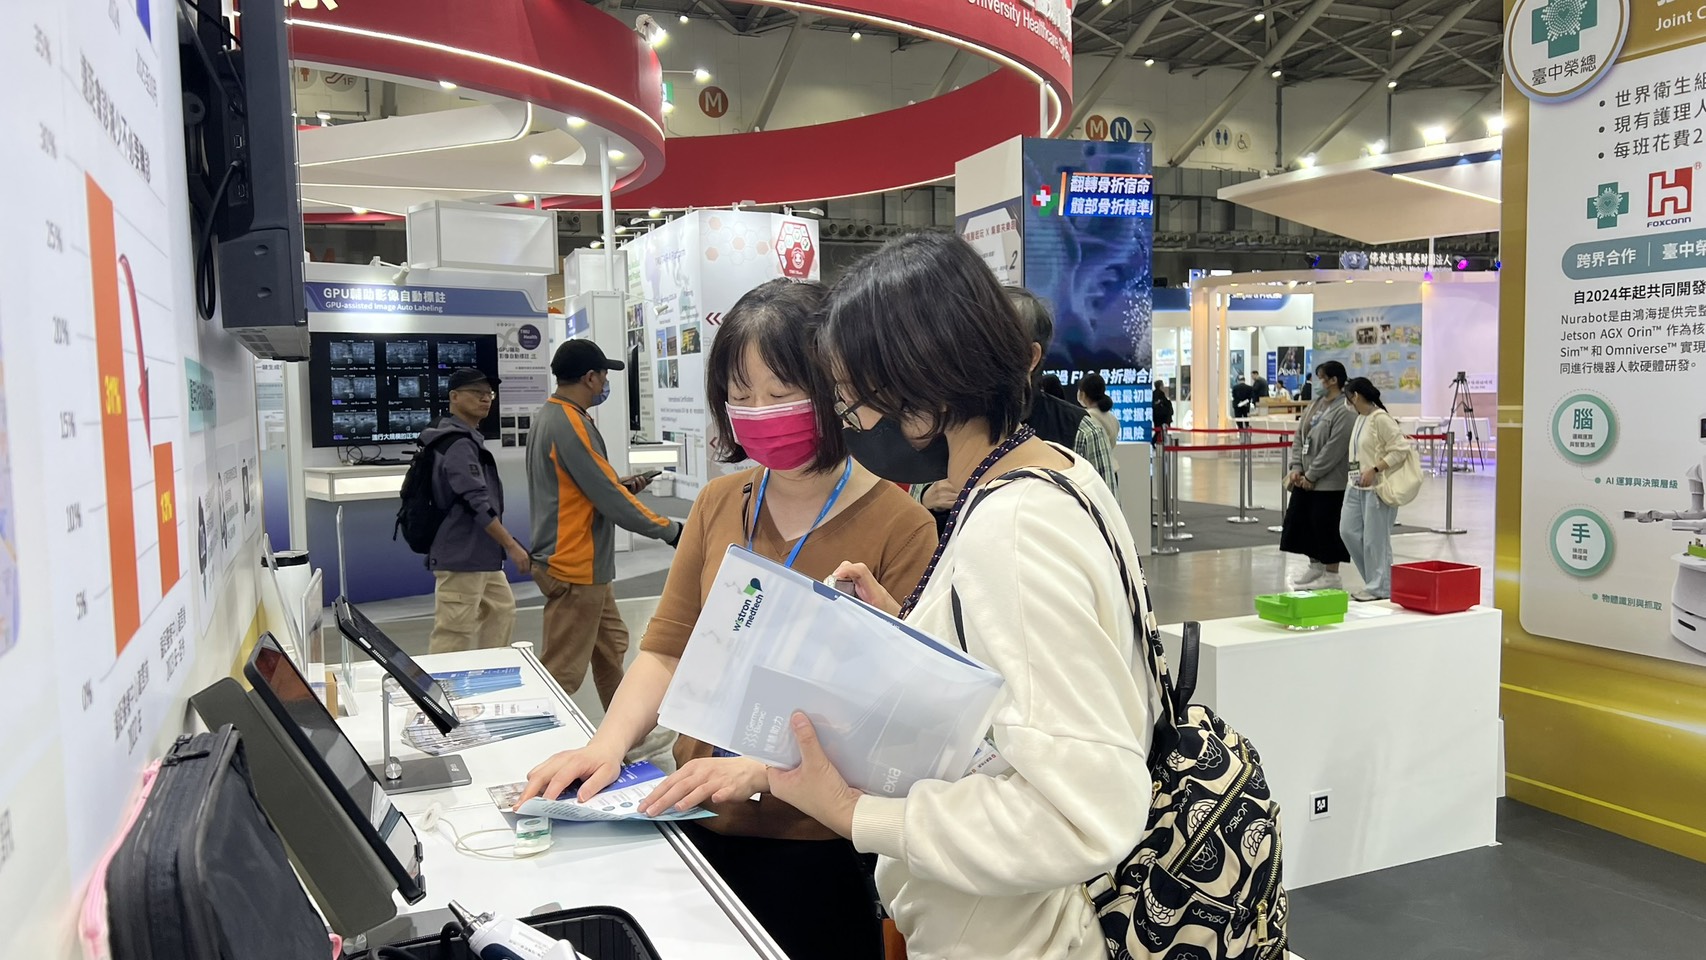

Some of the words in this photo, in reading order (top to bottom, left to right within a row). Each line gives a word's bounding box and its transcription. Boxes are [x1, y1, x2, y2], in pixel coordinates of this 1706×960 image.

[1023, 9, 1059, 49] Healthcare
[1655, 13, 1693, 32] Joint
[1531, 54, 1597, 86] 臺中榮總
[705, 92, 722, 113] M
[1090, 120, 1105, 138] M
[1115, 121, 1128, 140] N
[1613, 127, 1704, 159] 每班花費2
[1070, 175, 1150, 195] 翻轉骨折宿命
[1070, 197, 1153, 217] 髖部骨折精準
[1009, 250, 1018, 270] 2
[1576, 247, 1637, 269] 跨界合作
[323, 287, 446, 304] GPU輔助影像自動標註
[1573, 280, 1706, 305] 自2024年起共同開發
[325, 301, 373, 310] GPU-assisted
[374, 302, 396, 312] Image
[397, 303, 413, 311] Auto
[414, 304, 443, 313] Labeling
[52, 317, 71, 346] 20%
[1560, 328, 1596, 342] Jetson
[1600, 327, 1623, 339] AGX
[1591, 345, 1602, 357] 和
[59, 411, 77, 440] 15%
[1573, 408, 1593, 430] 腦
[1605, 477, 1614, 485] AI
[1616, 476, 1678, 490] 運算與決策層級
[65, 504, 83, 533] 10%
[1571, 523, 1591, 544] 手
[732, 597, 753, 633] wistron
[745, 593, 765, 629] medtech
[882, 767, 902, 795] exia
